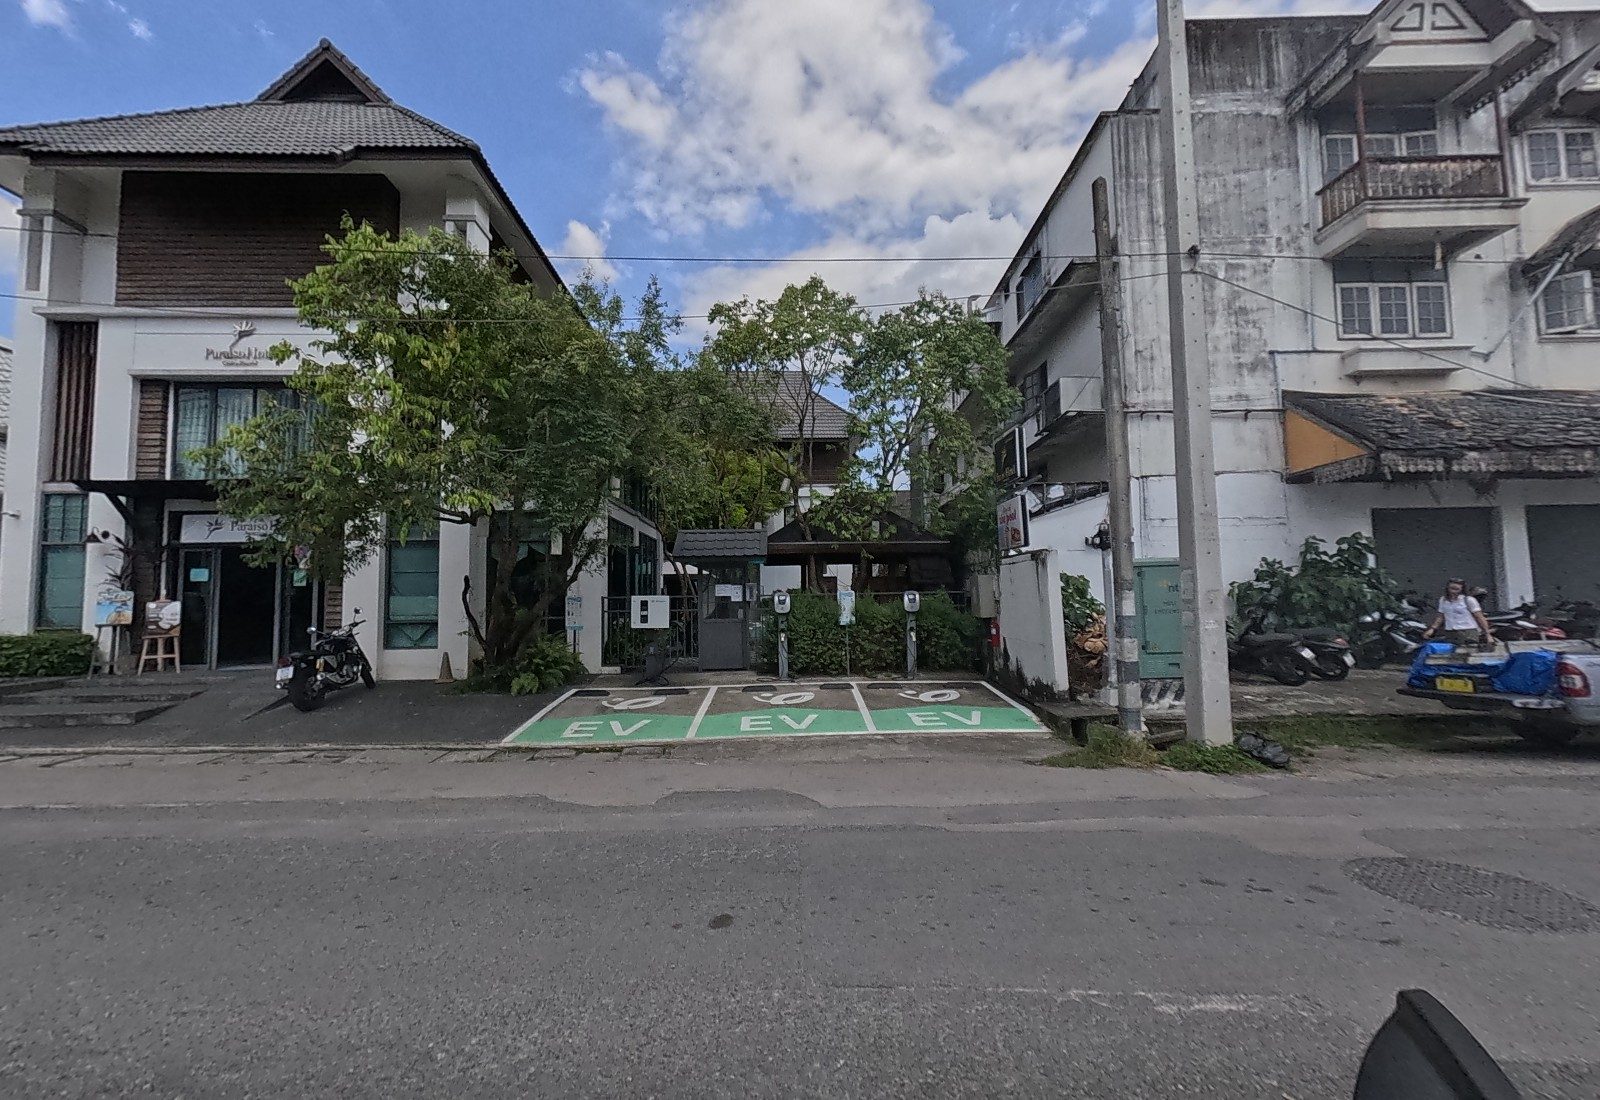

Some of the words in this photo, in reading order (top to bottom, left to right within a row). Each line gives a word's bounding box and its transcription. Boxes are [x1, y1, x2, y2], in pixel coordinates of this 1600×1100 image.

[740, 714, 819, 732] EV
[907, 710, 981, 727] EV
[560, 720, 653, 738] EV
